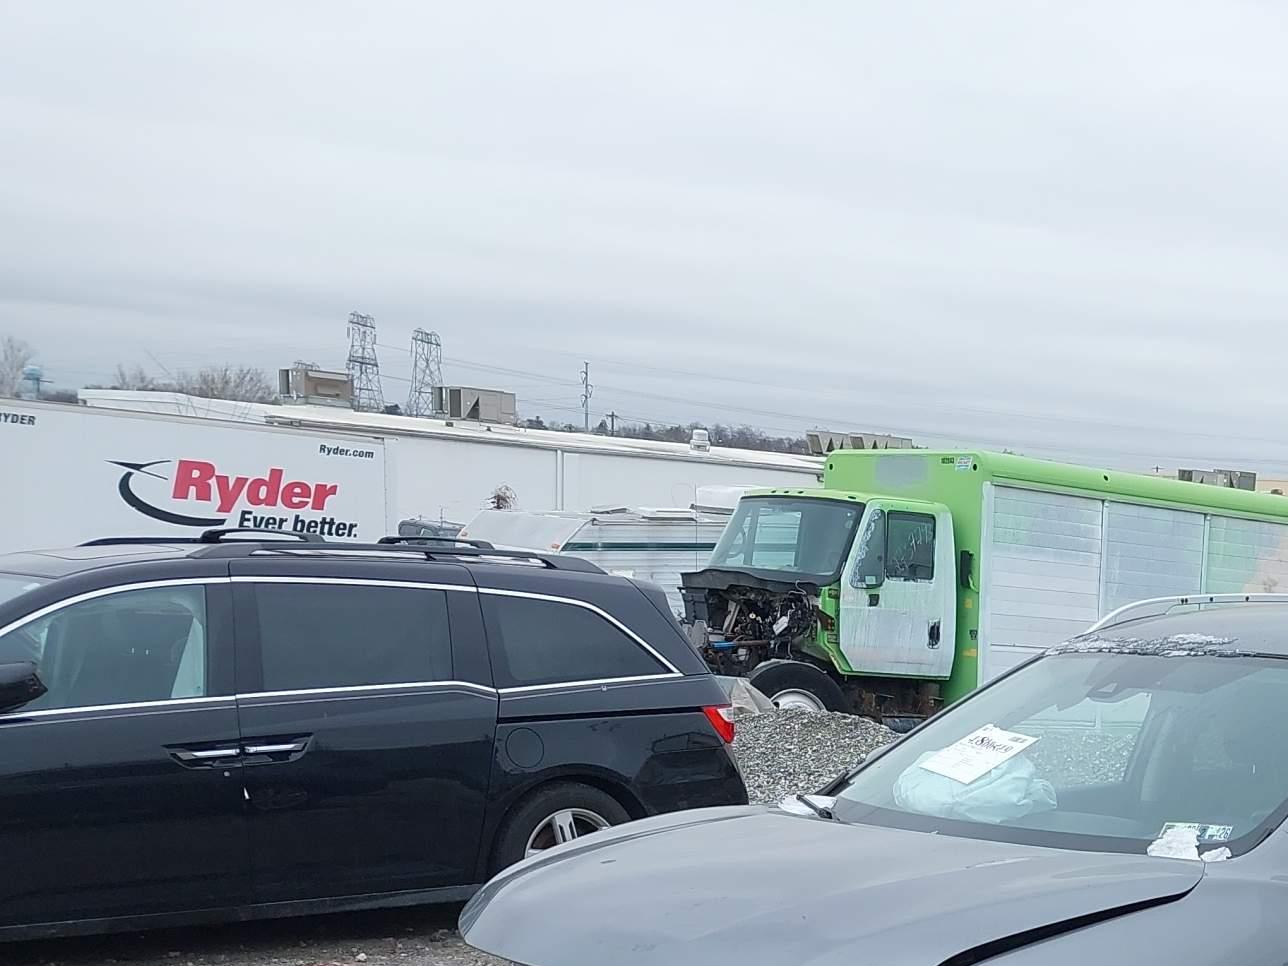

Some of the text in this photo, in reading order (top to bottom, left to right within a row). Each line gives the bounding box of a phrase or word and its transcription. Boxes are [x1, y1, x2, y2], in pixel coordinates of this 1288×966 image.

[0, 412, 36, 426] YDER
[319, 444, 374, 459] Ryder.com
[172, 459, 338, 513] Ryder
[239, 510, 358, 538] Ever better.
